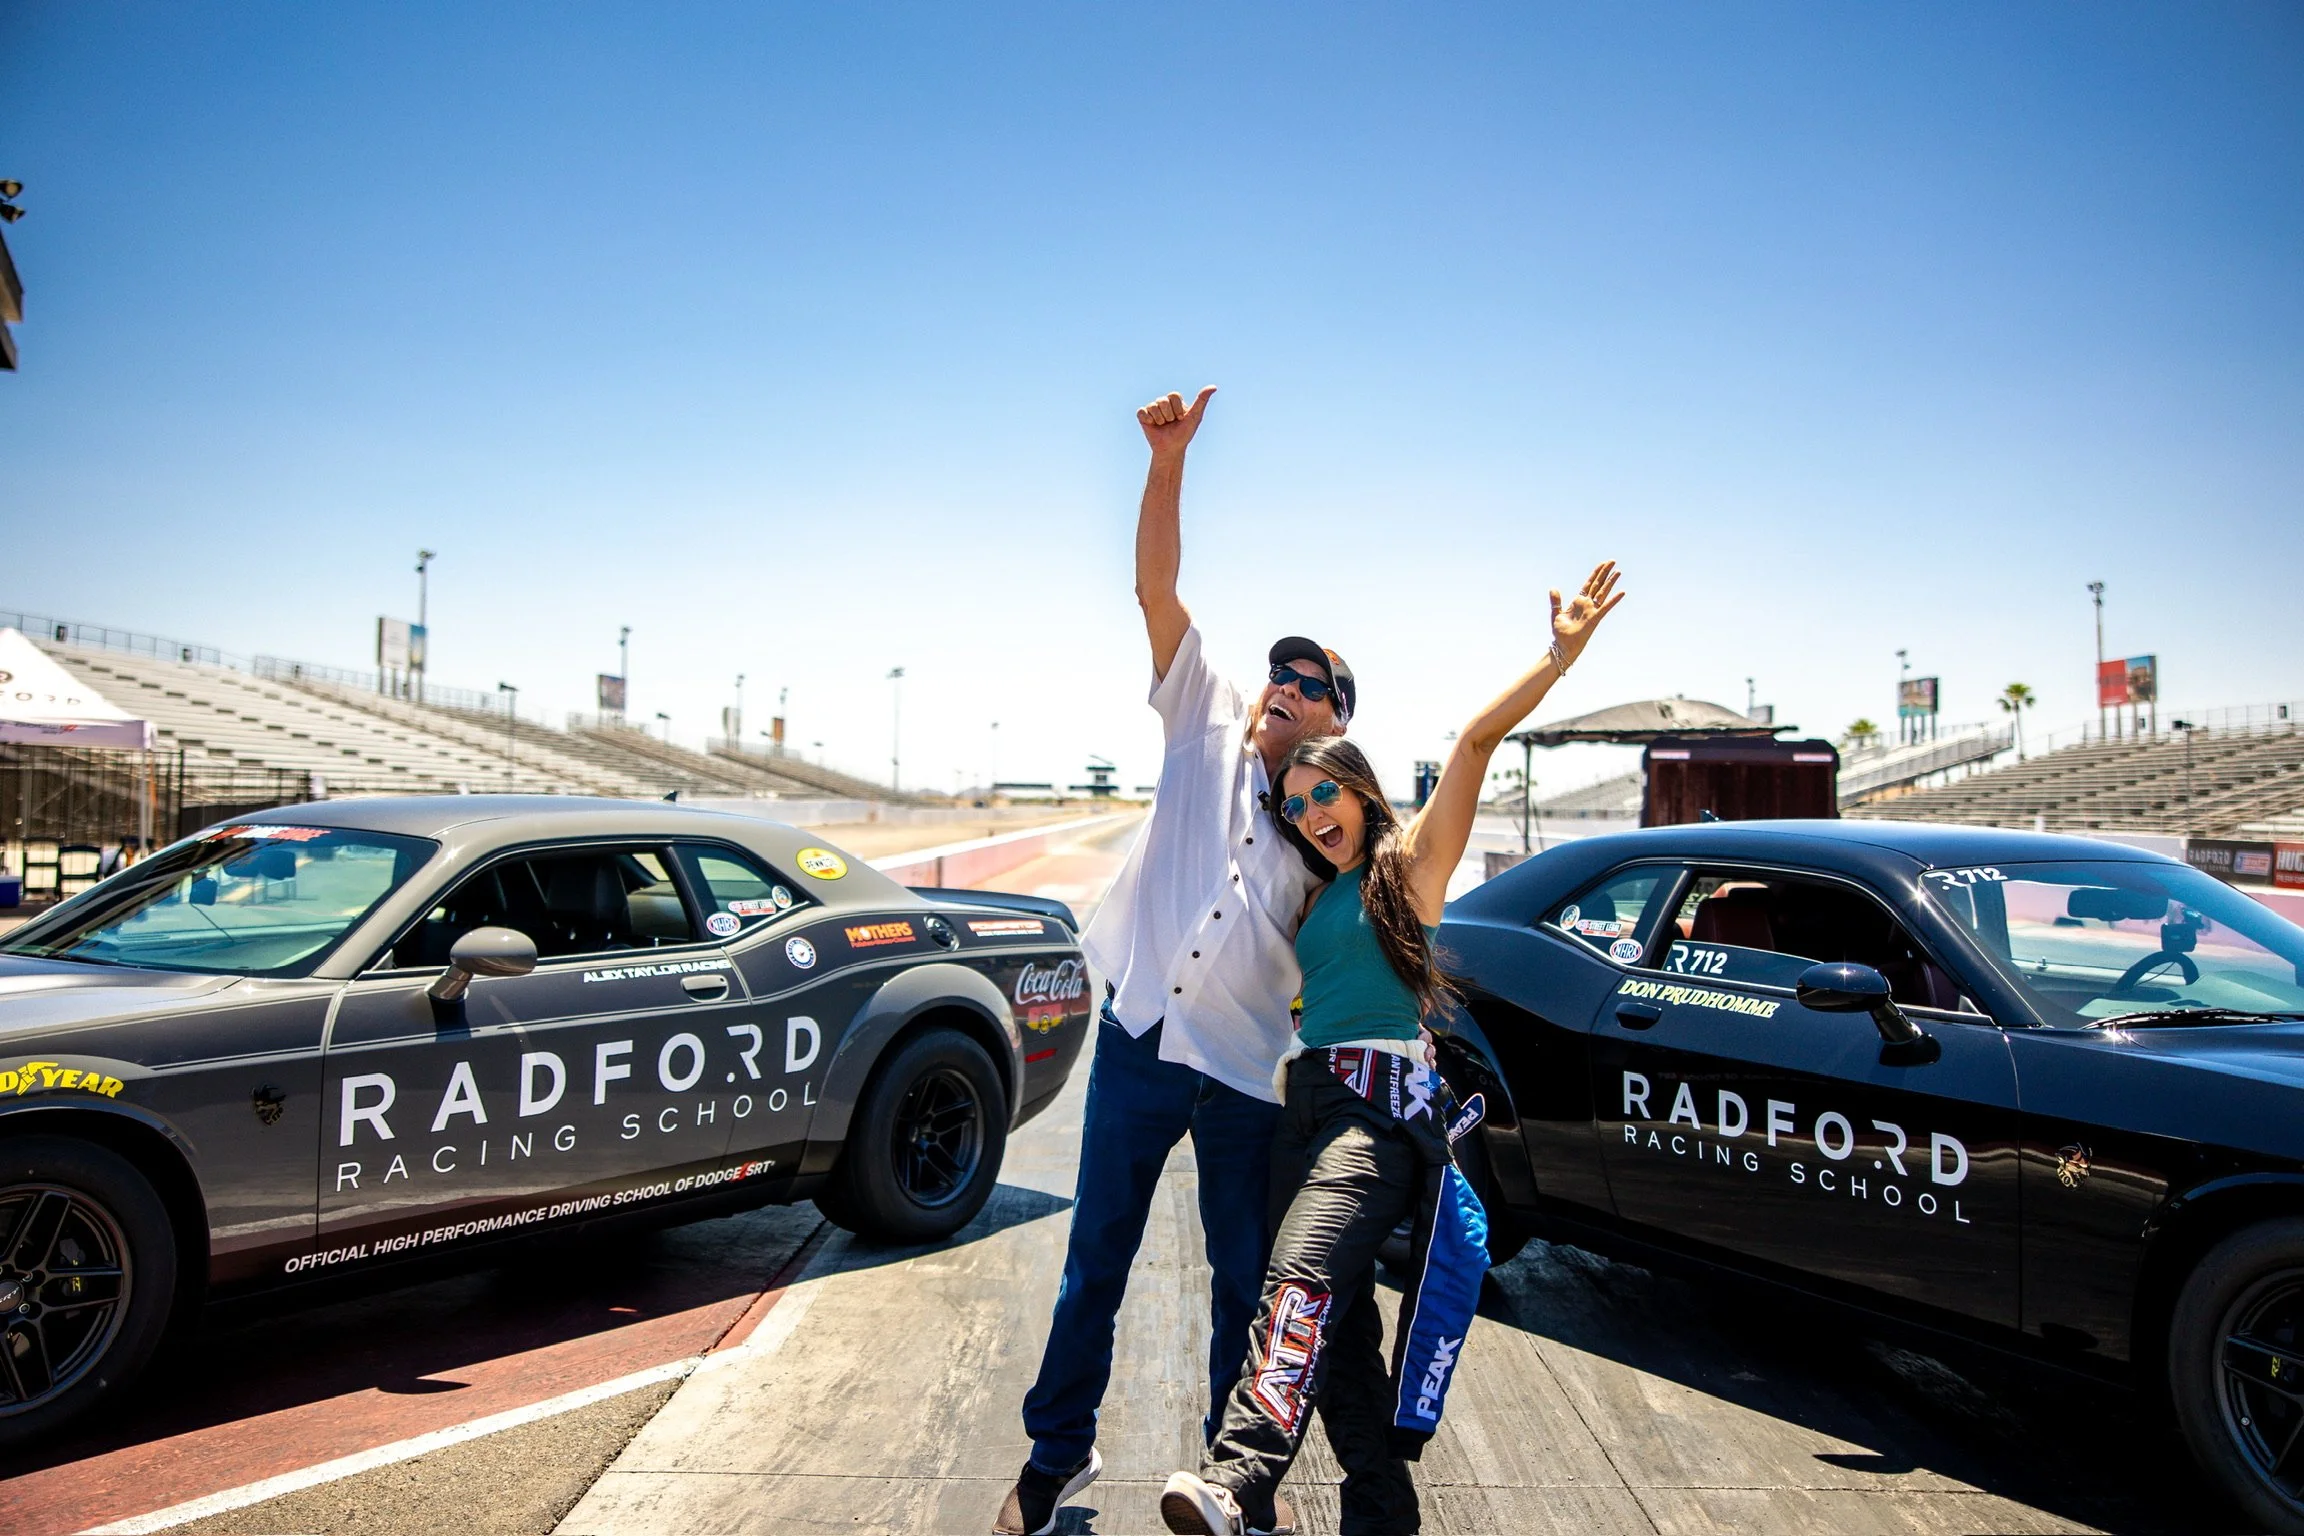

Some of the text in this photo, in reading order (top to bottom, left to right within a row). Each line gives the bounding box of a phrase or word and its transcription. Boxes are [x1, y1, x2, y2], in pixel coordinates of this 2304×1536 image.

[711, 917, 736, 932] NHRA
[845, 922, 913, 942] MOTHERS
[1614, 943, 1639, 959] NHRA
[583, 969, 626, 983] ALEX
[622, 963, 683, 979] TAYLOR
[1617, 979, 1781, 1018] DON PRUDHOMME
[340, 1016, 821, 1147] RADFORD
[1390, 1054, 1402, 1119] ANTIFREEZE
[336, 1081, 817, 1192] RACING SCHOOL
[1623, 1070, 1969, 1186] RADFORD
[1624, 1125, 1970, 1224] RACING SCHOOL
[284, 1244, 369, 1273] OFFICIAL
[373, 1232, 420, 1255] HIGH
[421, 1206, 547, 1246] PERFORMANCE
[548, 1195, 611, 1219] DRIVING
[613, 1183, 671, 1206] SCHOOL
[674, 1176, 695, 1192] OF
[1253, 1282, 1326, 1429] ATR
[1416, 1335, 1462, 1421] PEAK
